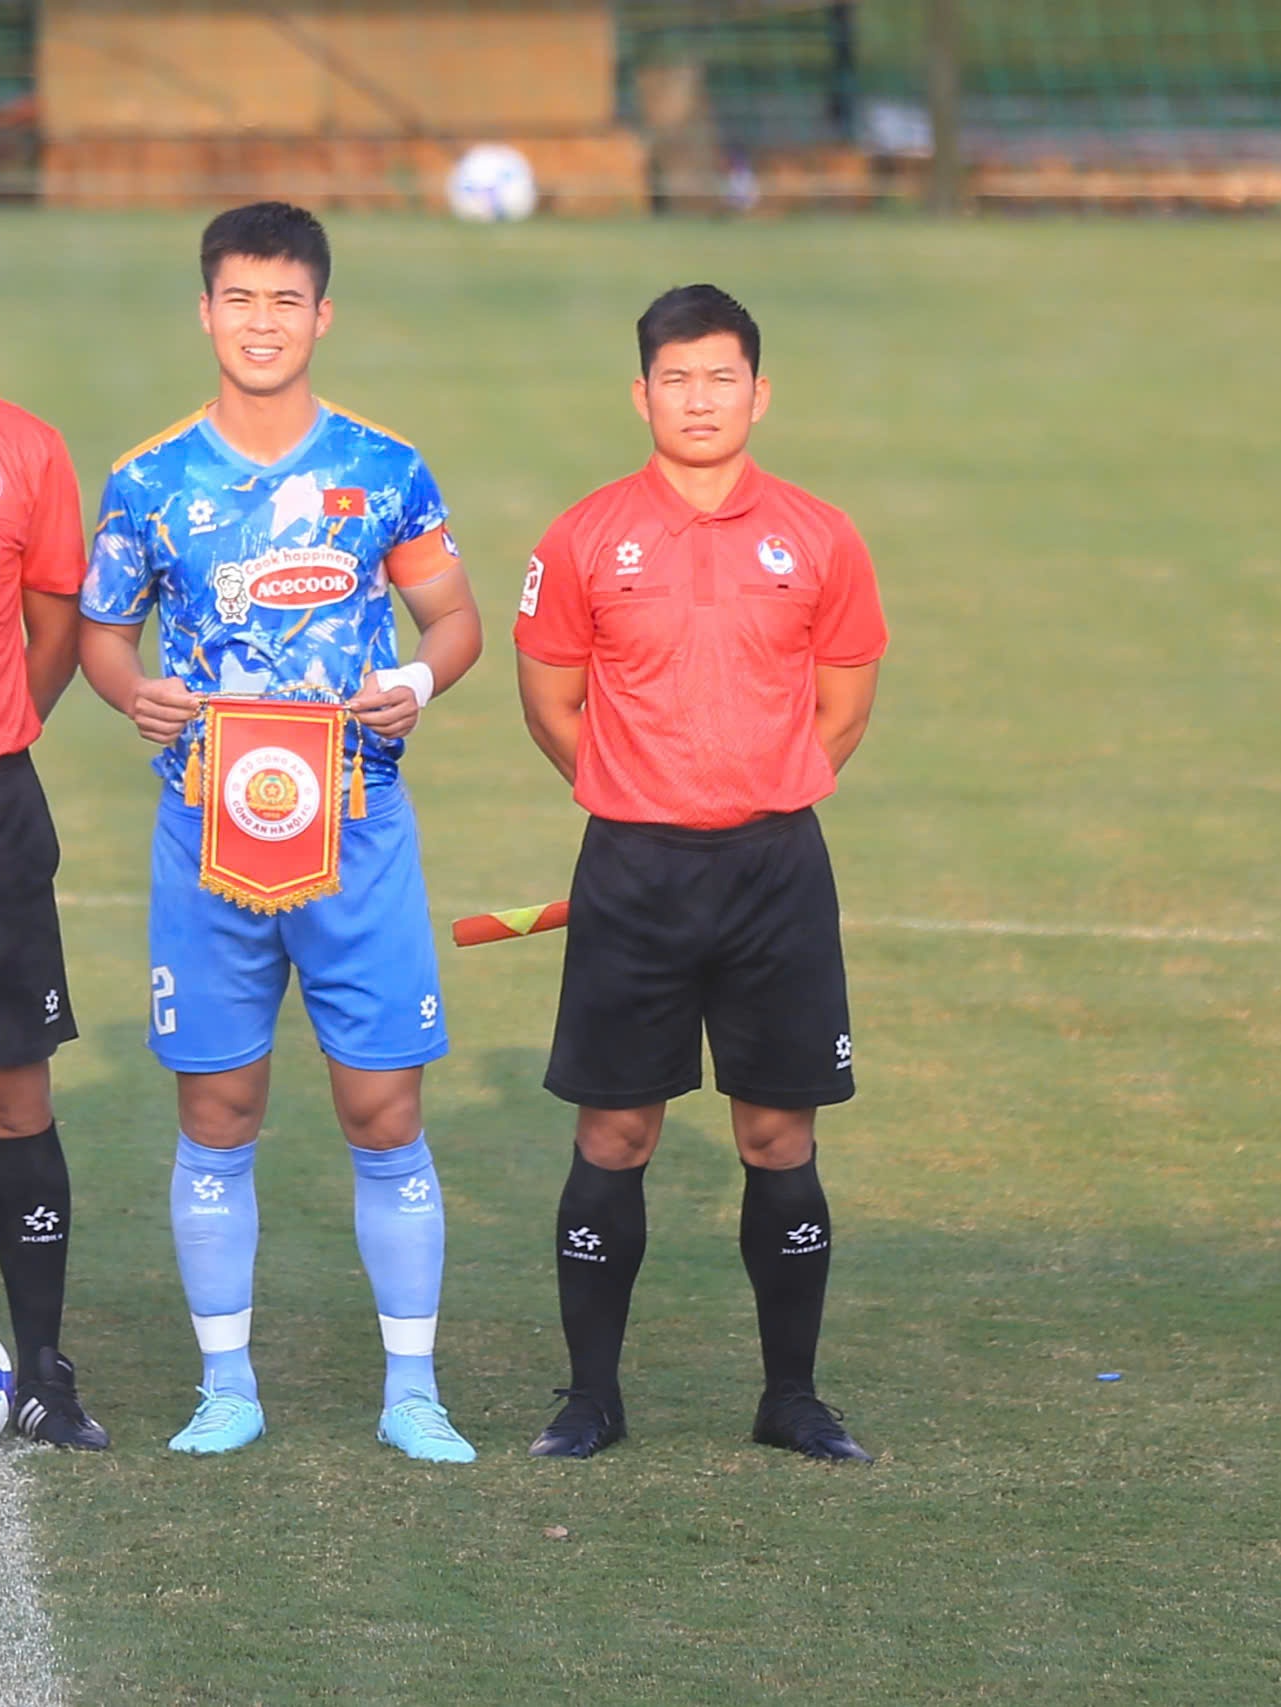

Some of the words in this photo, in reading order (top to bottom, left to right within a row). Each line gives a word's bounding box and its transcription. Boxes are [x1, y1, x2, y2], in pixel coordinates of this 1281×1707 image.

[245, 552, 278, 575] Cook
[283, 550, 355, 568] happiness
[252, 822, 269, 834] AN
[151, 969, 177, 1036] 2
